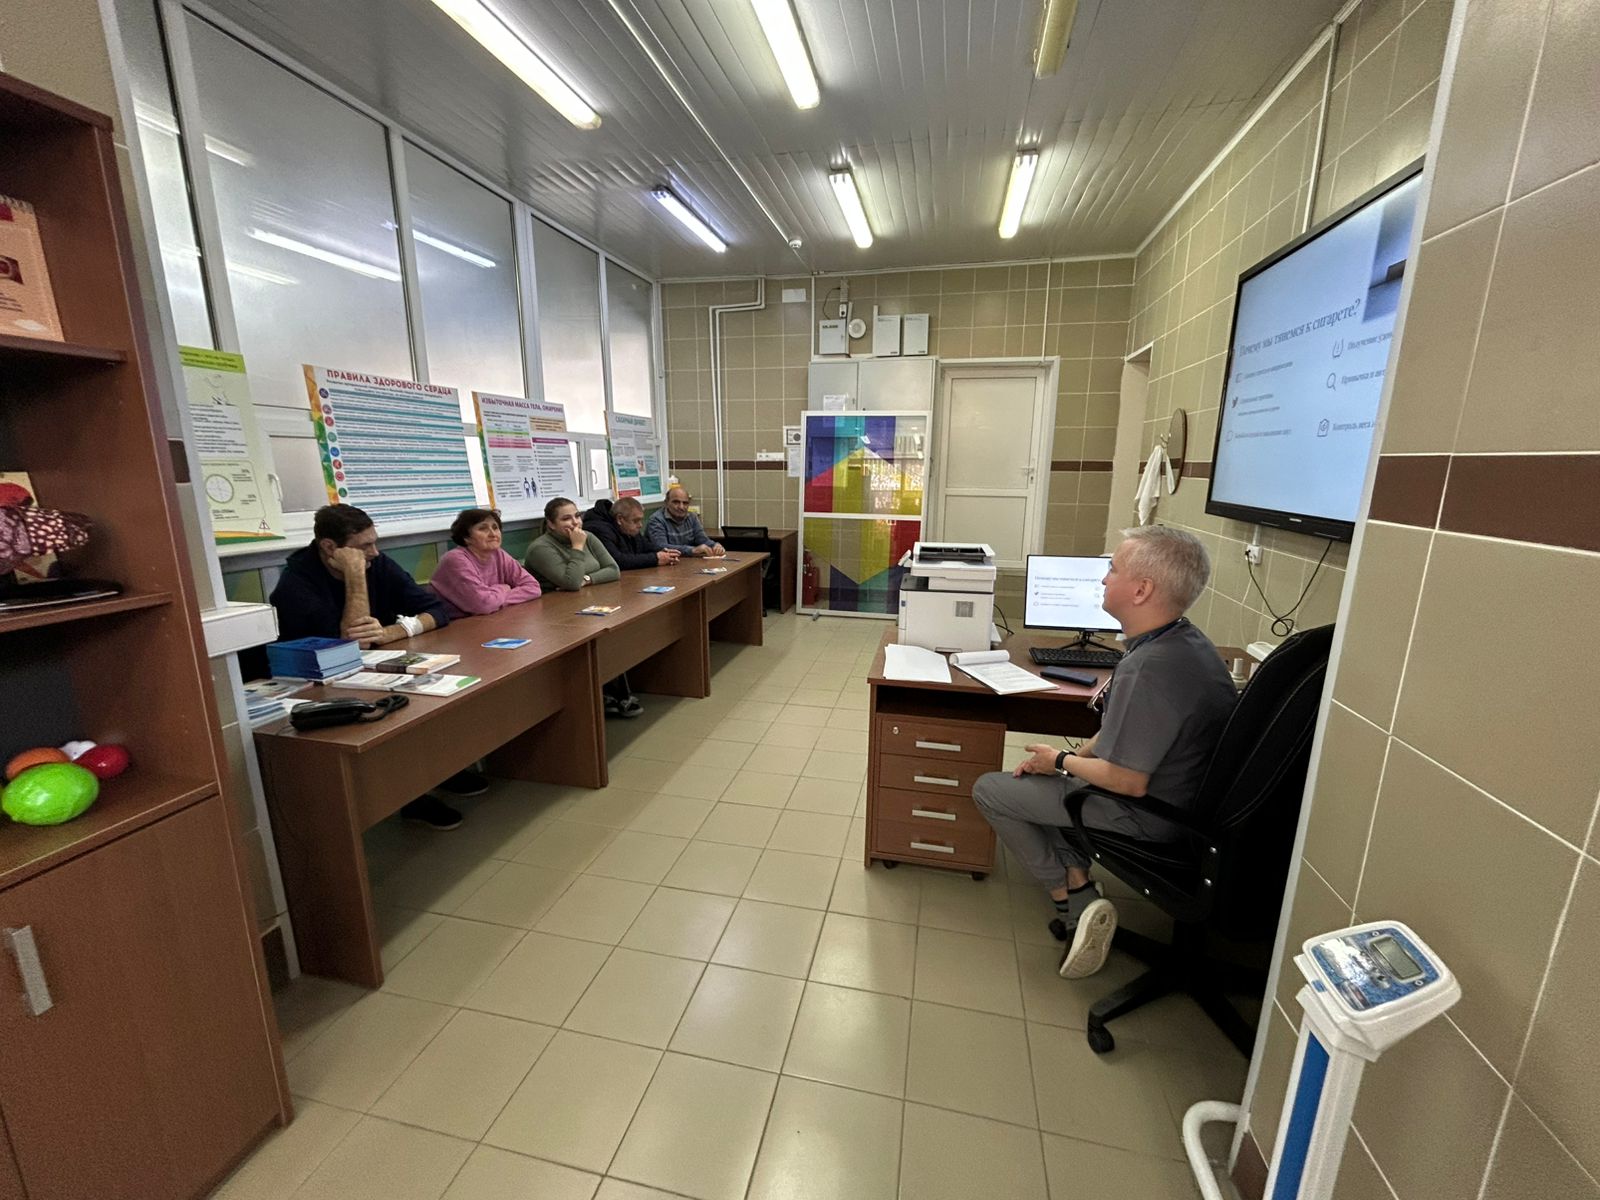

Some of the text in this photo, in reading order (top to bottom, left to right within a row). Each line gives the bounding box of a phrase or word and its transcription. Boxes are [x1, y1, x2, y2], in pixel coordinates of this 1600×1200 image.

[1274, 325, 1305, 345] тянемся
[1304, 322, 1312, 334] к
[1312, 298, 1361, 331] сигарете?
[326, 369, 371, 384] ПРАВИЛА
[373, 376, 423, 391] ЗДОРОВОГО
[423, 385, 453, 396] СЕРДЦА
[481, 397, 514, 407] ИЗБЫТОЧНАЯ
[515, 401, 530, 409] МАССА
